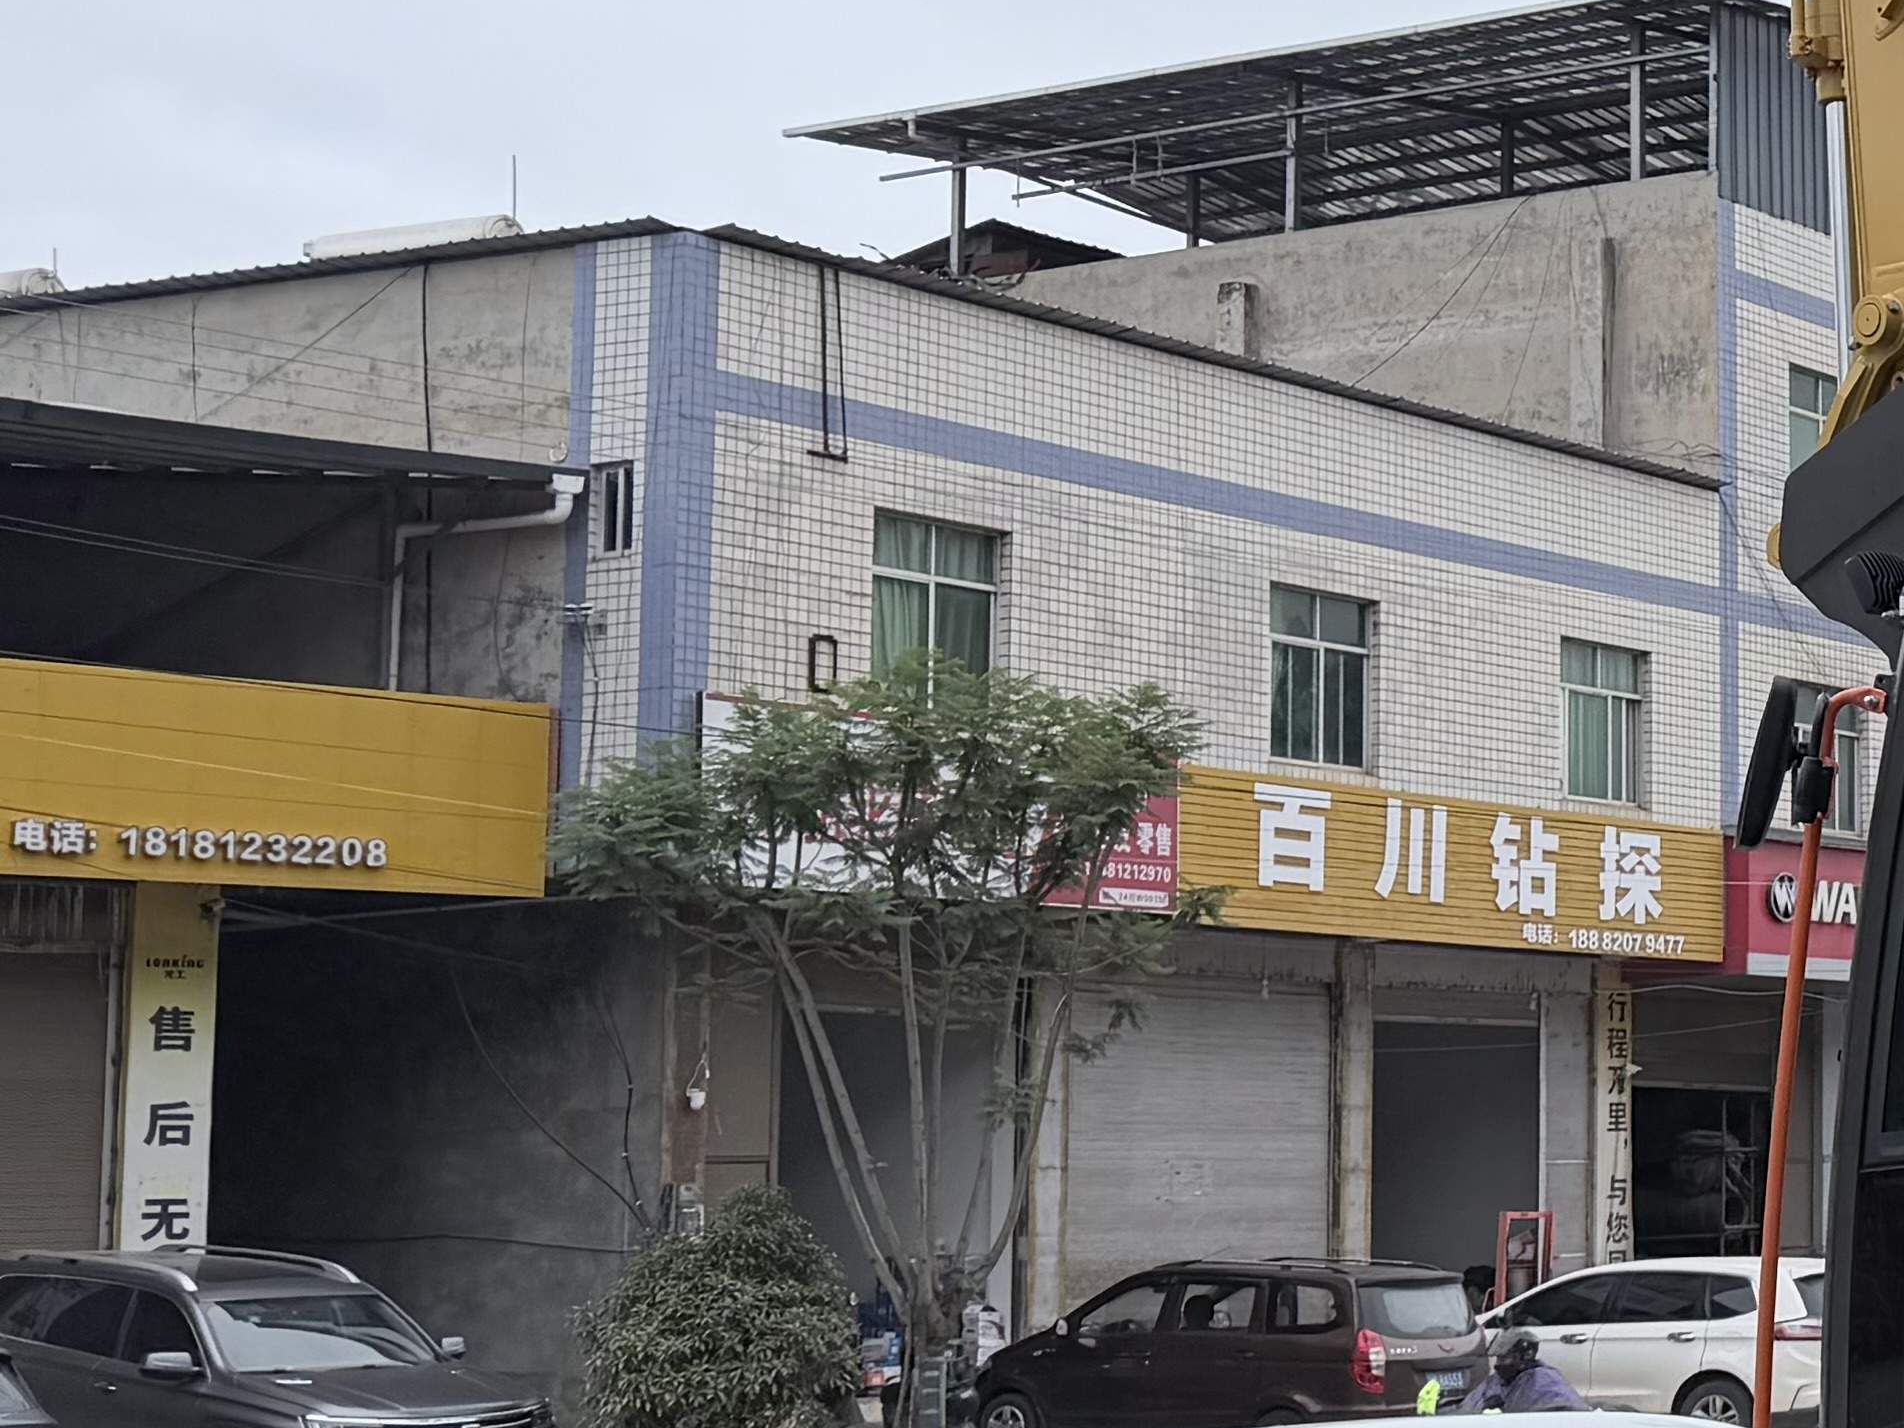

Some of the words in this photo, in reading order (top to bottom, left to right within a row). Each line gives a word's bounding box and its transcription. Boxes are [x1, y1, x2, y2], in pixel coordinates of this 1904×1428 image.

[120, 825, 388, 869] 18181232208
[1136, 822, 1172, 857] 零售
[1252, 782, 1665, 925] 百川钻探
[1084, 861, 1172, 883] 181212970
